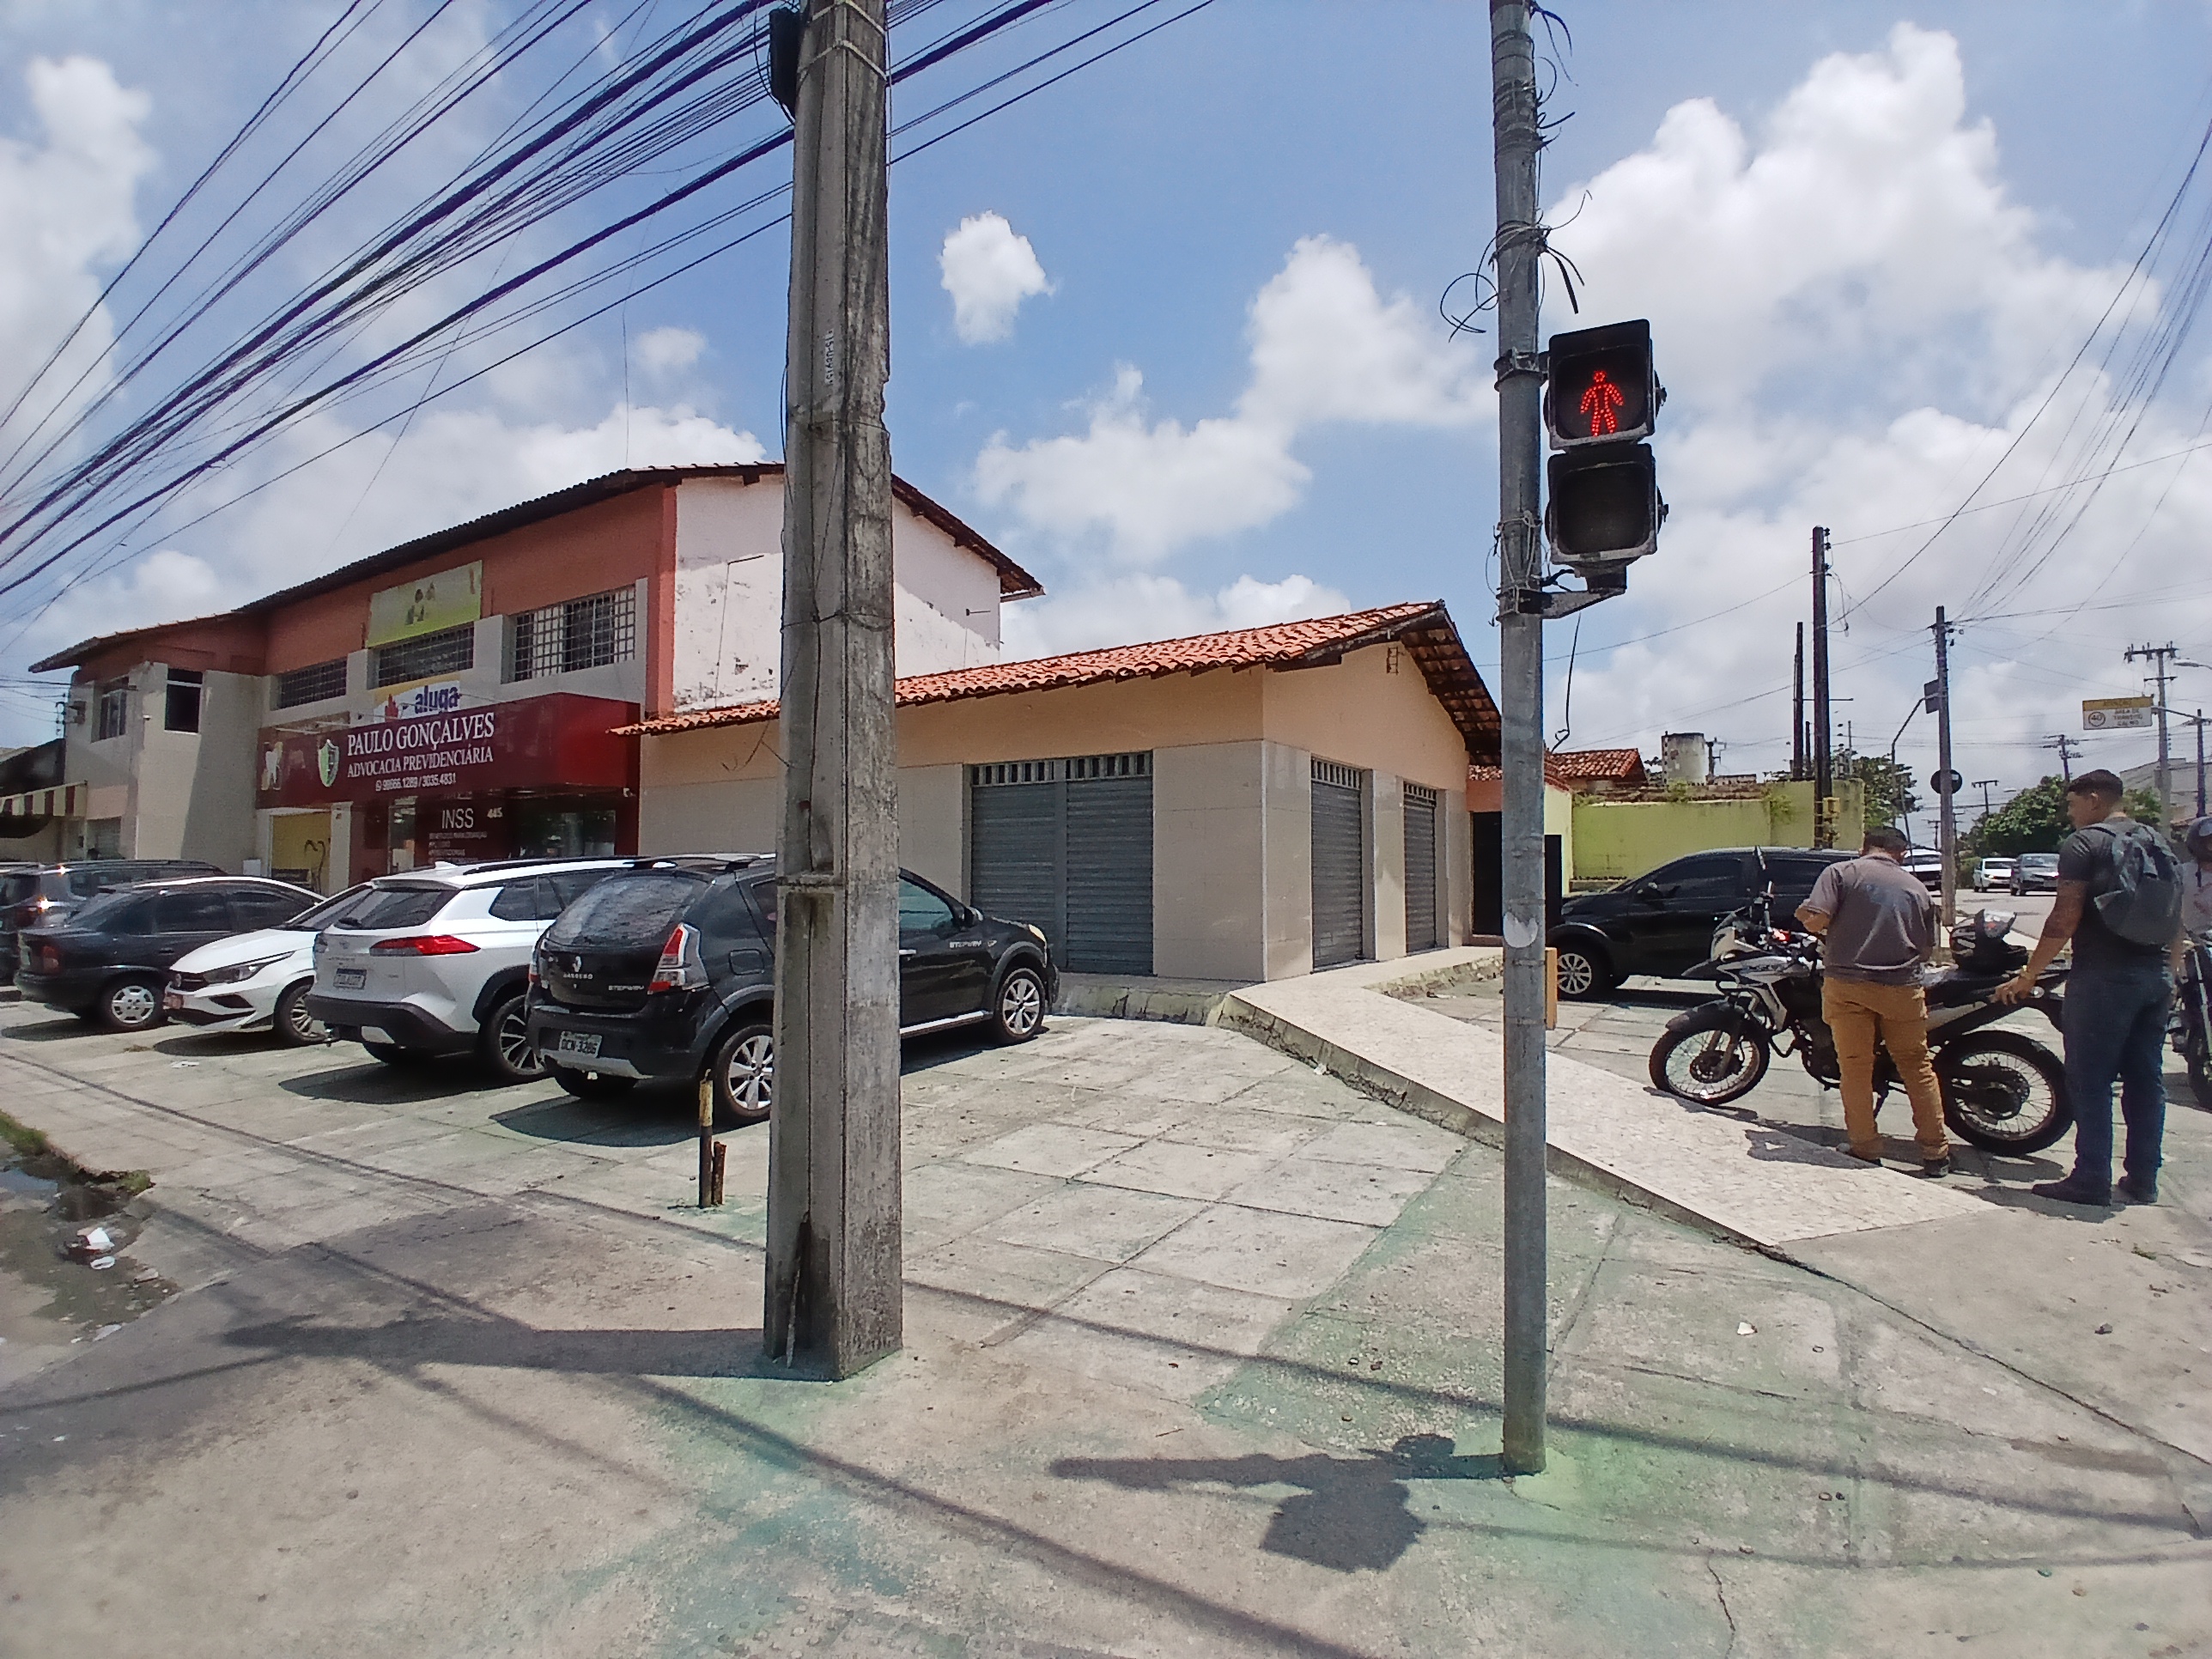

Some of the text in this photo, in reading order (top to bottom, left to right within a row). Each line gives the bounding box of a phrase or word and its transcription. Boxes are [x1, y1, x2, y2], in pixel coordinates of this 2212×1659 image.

[415, 685, 460, 714] aluga
[347, 712, 495, 757] PAULO GONÇALVES
[347, 744, 494, 778] ADVOCACIA PREVIDENCIÁRIA
[441, 807, 474, 830] INSS
